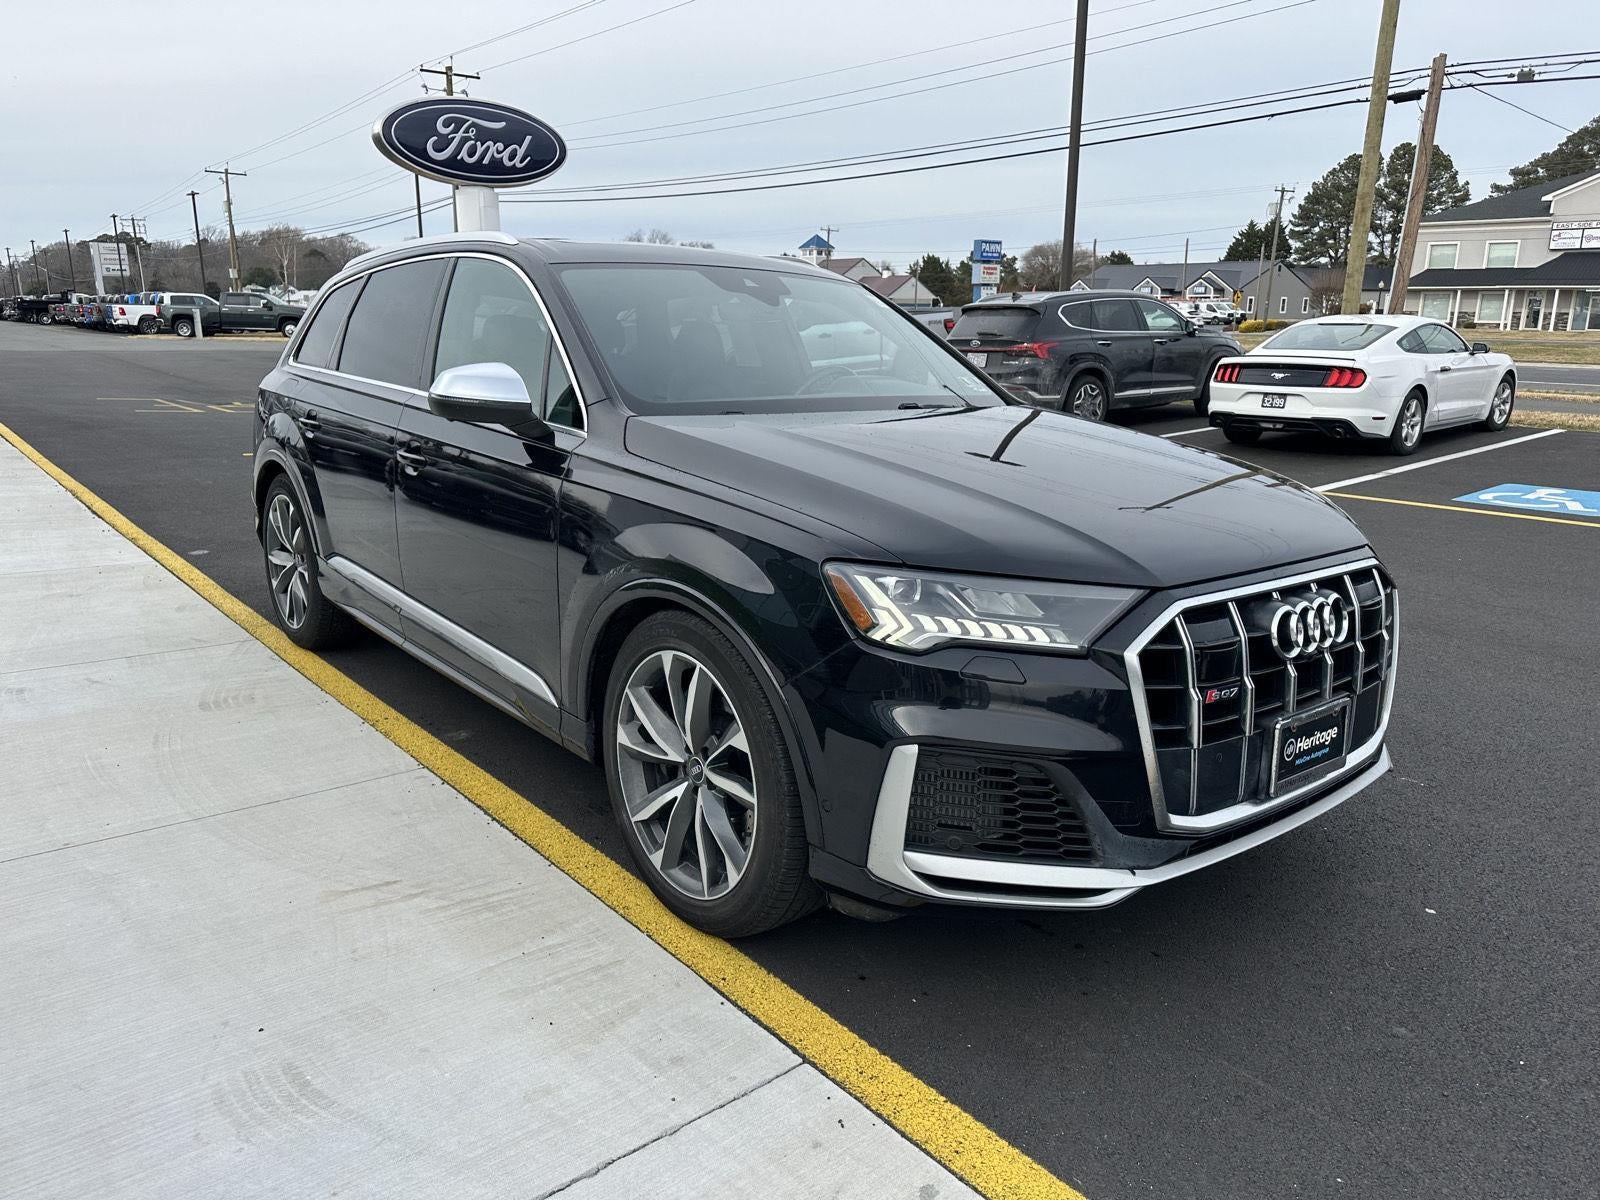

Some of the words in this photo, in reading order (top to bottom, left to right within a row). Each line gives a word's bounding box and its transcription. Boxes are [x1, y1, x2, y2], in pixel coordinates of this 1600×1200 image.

[427, 113, 532, 168] Ford
[981, 243, 1001, 253] PAWN
[1211, 687, 1239, 700] SQ7
[1296, 726, 1338, 754] Heritage
